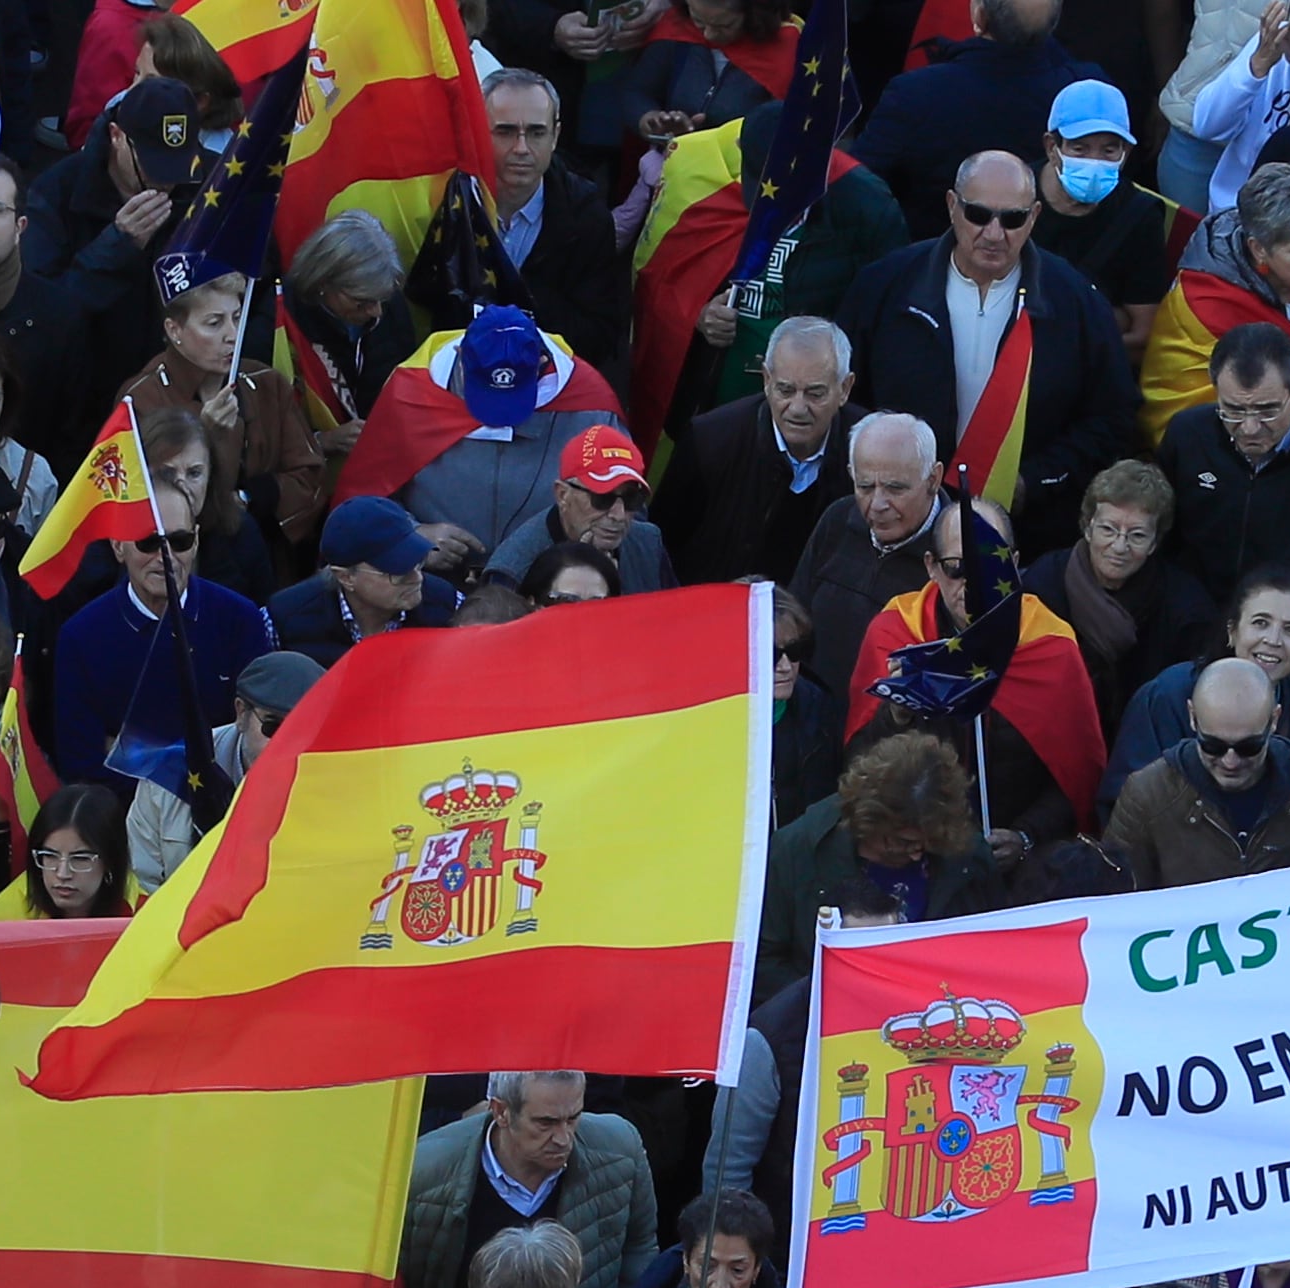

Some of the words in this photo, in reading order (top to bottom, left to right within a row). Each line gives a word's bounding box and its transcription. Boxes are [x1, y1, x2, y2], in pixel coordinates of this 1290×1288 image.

[1117, 1054, 1229, 1119] NO
[833, 1119, 876, 1138] PLVS
[1141, 1183, 1194, 1229] NI
